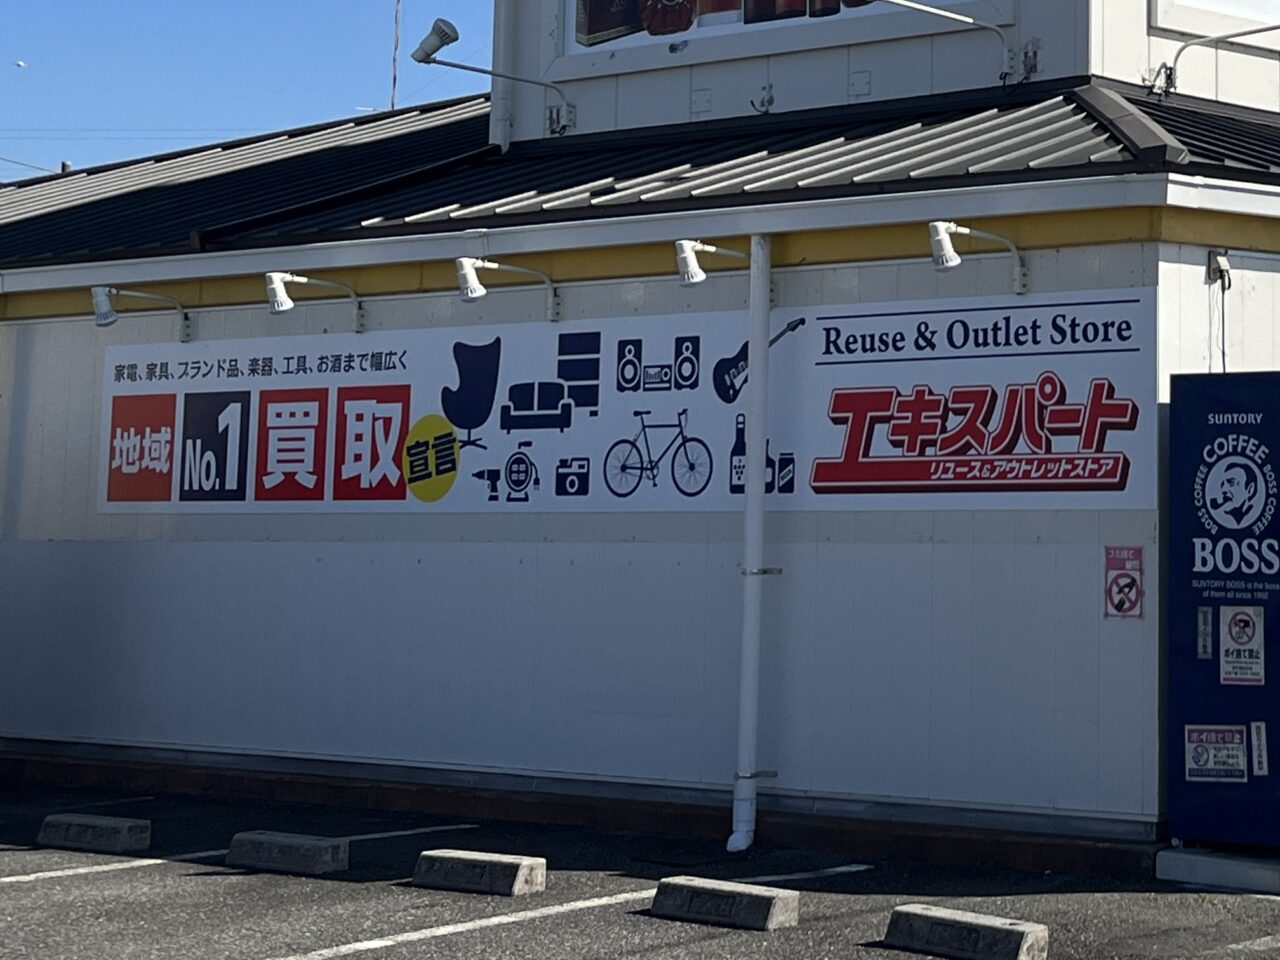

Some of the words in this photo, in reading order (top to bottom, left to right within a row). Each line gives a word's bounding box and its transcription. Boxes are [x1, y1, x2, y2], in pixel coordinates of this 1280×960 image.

[822, 326, 906, 355] Reuse
[913, 321, 938, 351] &
[946, 314, 1041, 349] Outlet
[1050, 313, 1133, 345] Store
[811, 370, 1140, 485] エキスパート
[1208, 413, 1263, 425] SUNTORY
[112, 426, 171, 474] 地域
[184, 401, 243, 490] No.1
[405, 431, 457, 484] 宣言
[1203, 434, 1269, 464] COFFEE
[1194, 464, 1208, 506] COFFEE
[1263, 464, 1277, 494] BOSS
[1197, 508, 1218, 535] BOSS
[1252, 497, 1277, 535] COFFEE
[1192, 538, 1280, 575] BOSS
